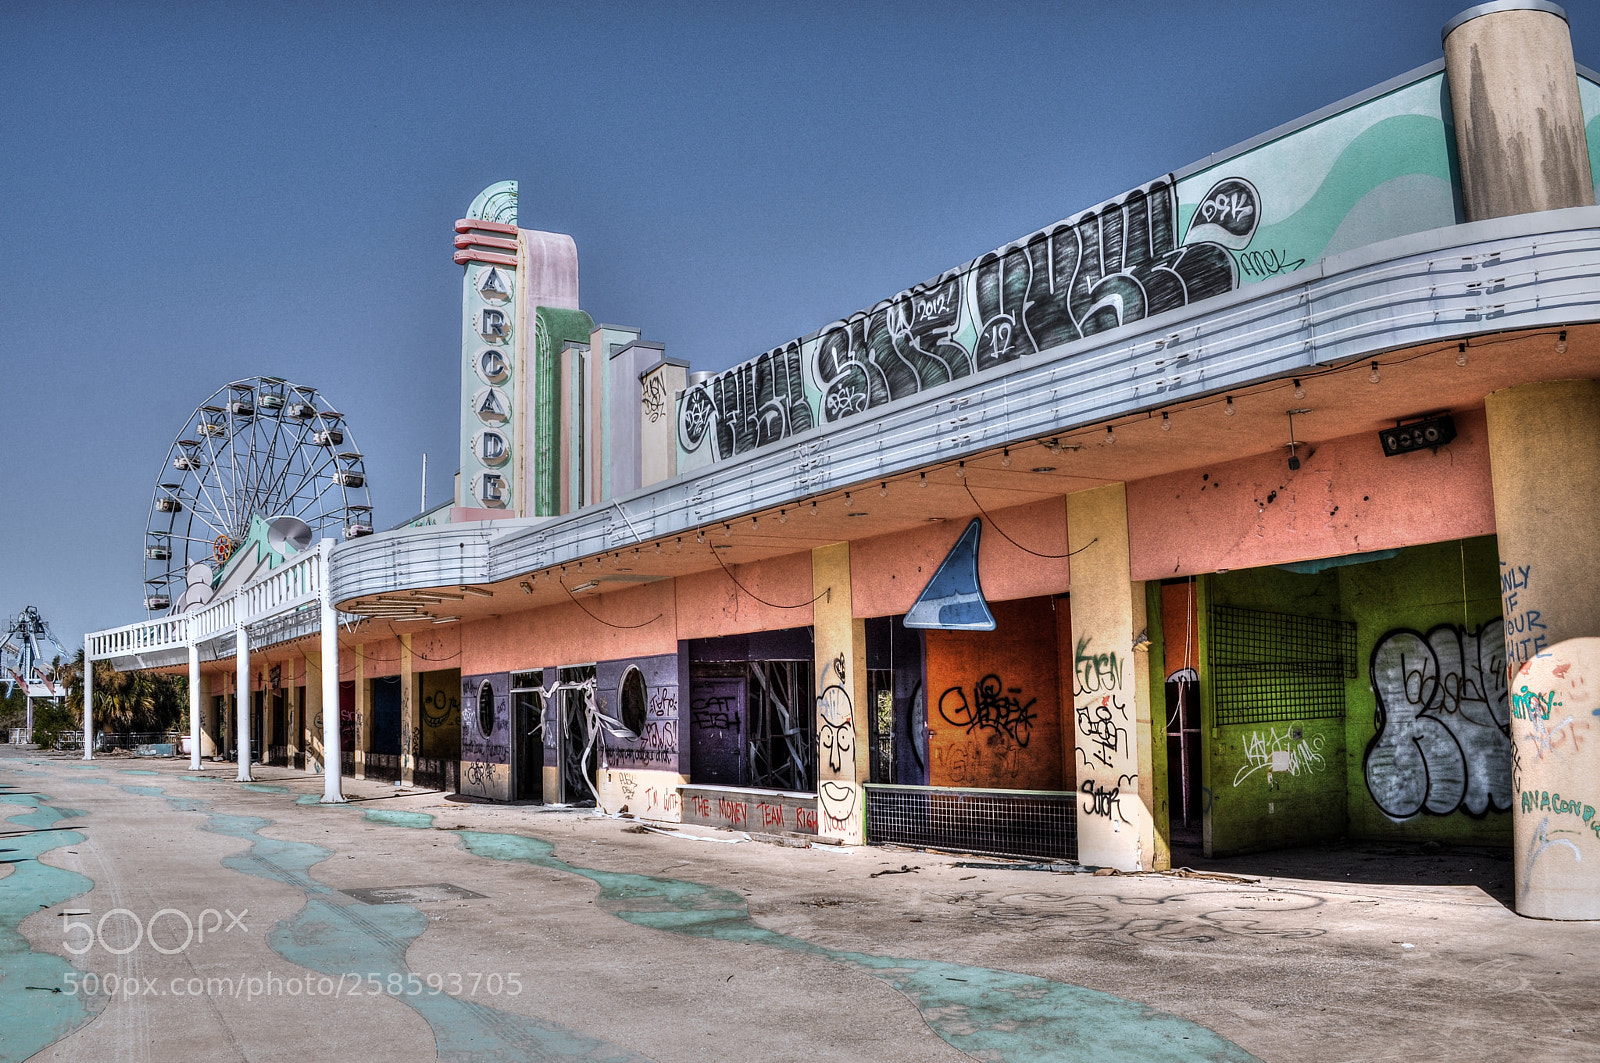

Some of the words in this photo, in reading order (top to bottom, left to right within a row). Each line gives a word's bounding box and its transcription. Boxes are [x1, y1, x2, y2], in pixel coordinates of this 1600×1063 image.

[477, 266, 509, 500] ARCADE
[1504, 611, 1547, 640] OUR
[690, 697, 736, 713] CAT
[691, 796, 710, 818] THE
[718, 798, 748, 828] MONEY
[756, 803, 785, 828] TEAM
